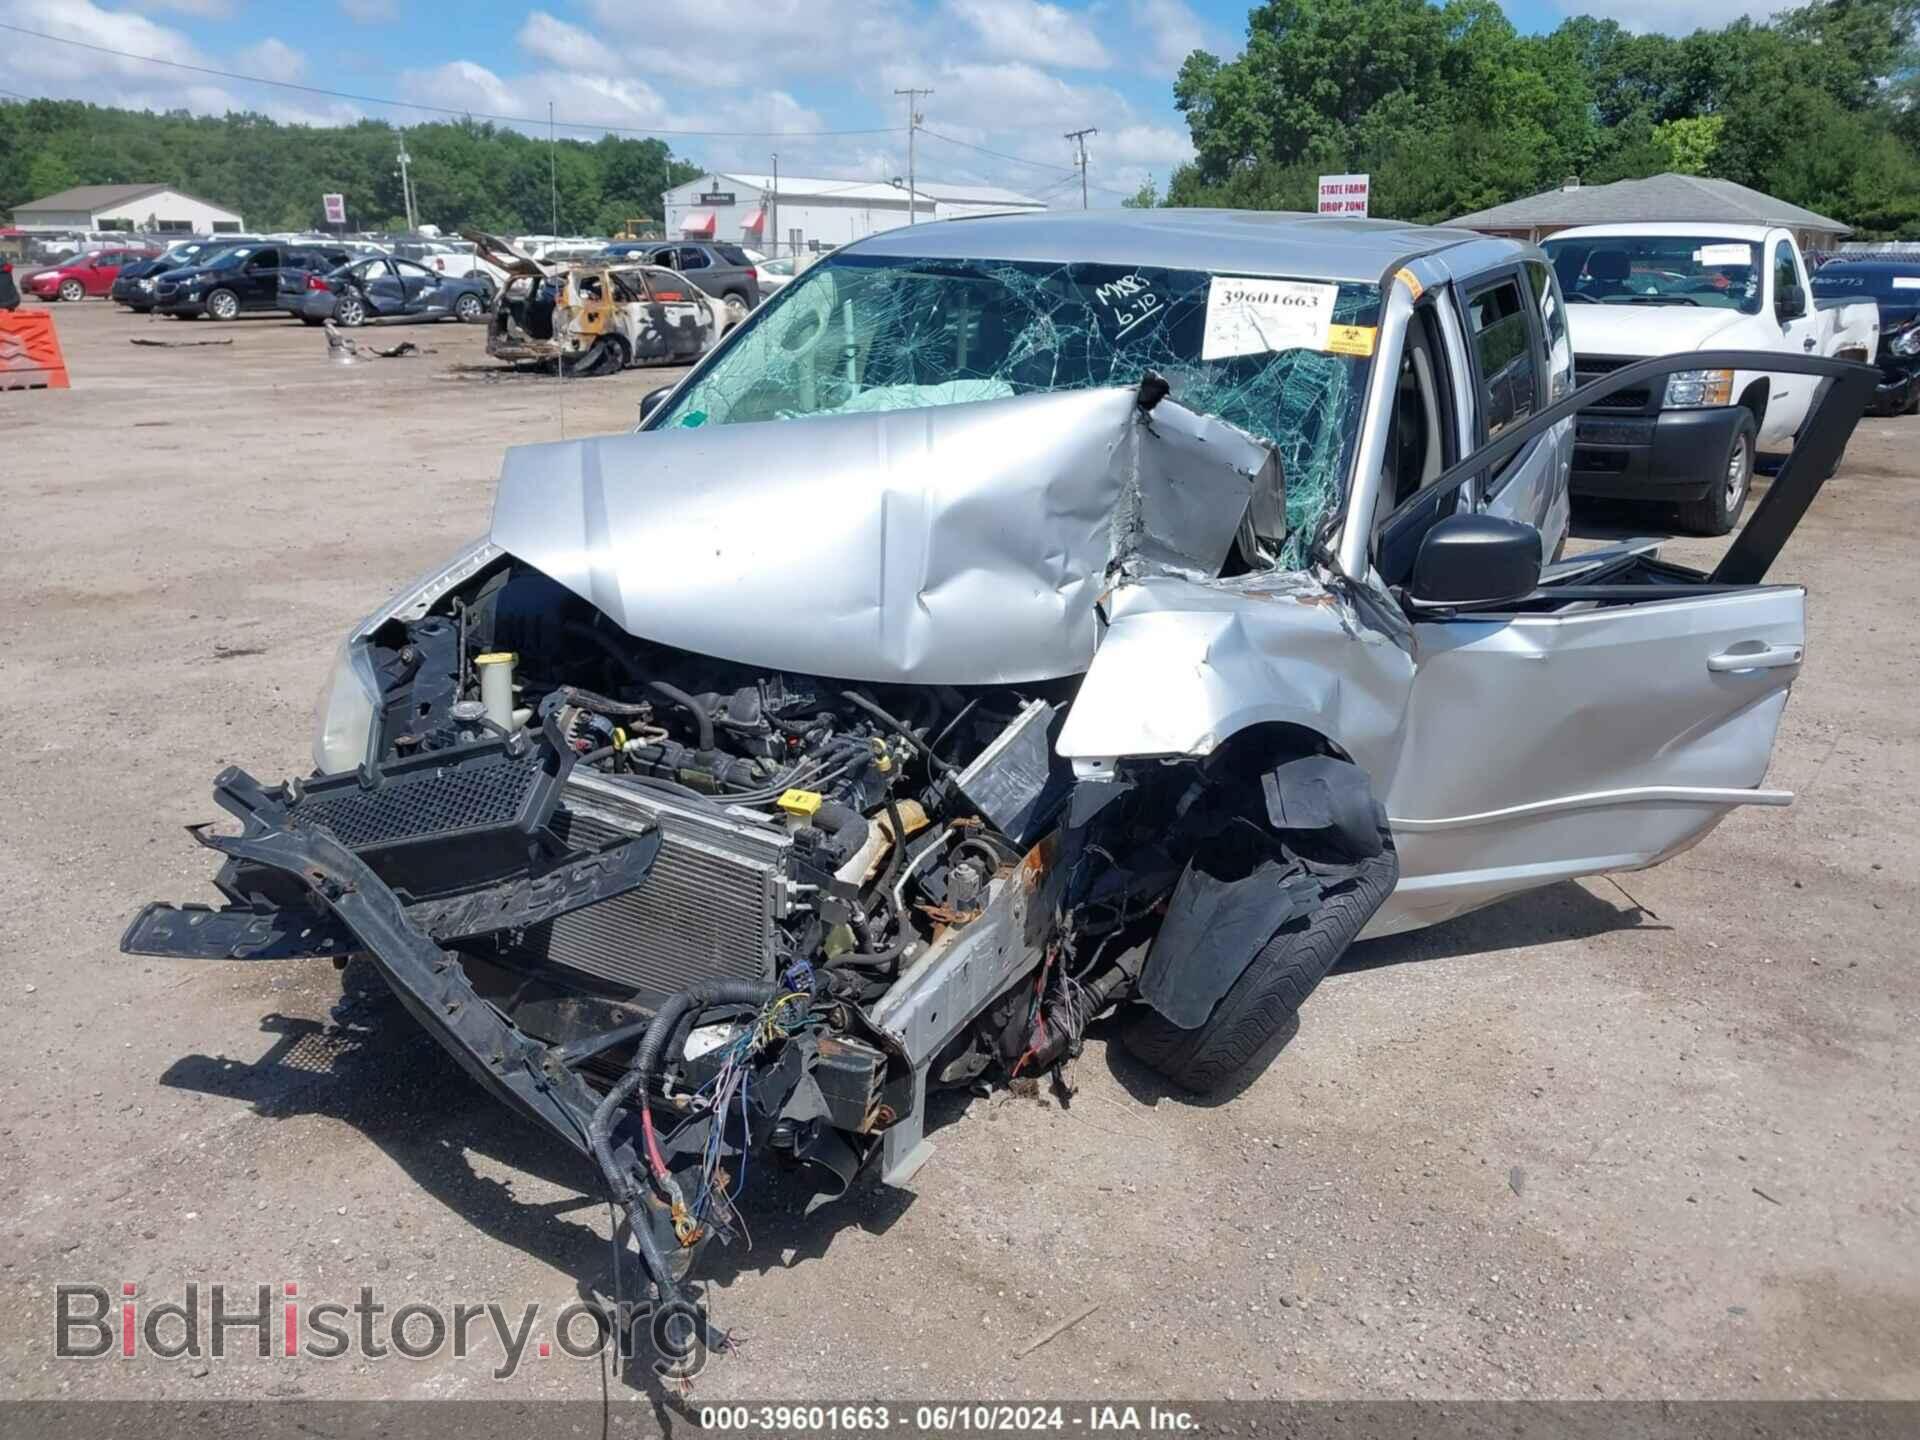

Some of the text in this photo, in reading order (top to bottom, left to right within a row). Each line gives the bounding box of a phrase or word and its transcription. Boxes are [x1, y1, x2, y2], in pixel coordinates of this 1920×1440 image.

[1320, 183, 1367, 195] STATE FARM
[1320, 200, 1366, 212] DROP ZONE
[1220, 290, 1319, 307] 39601663
